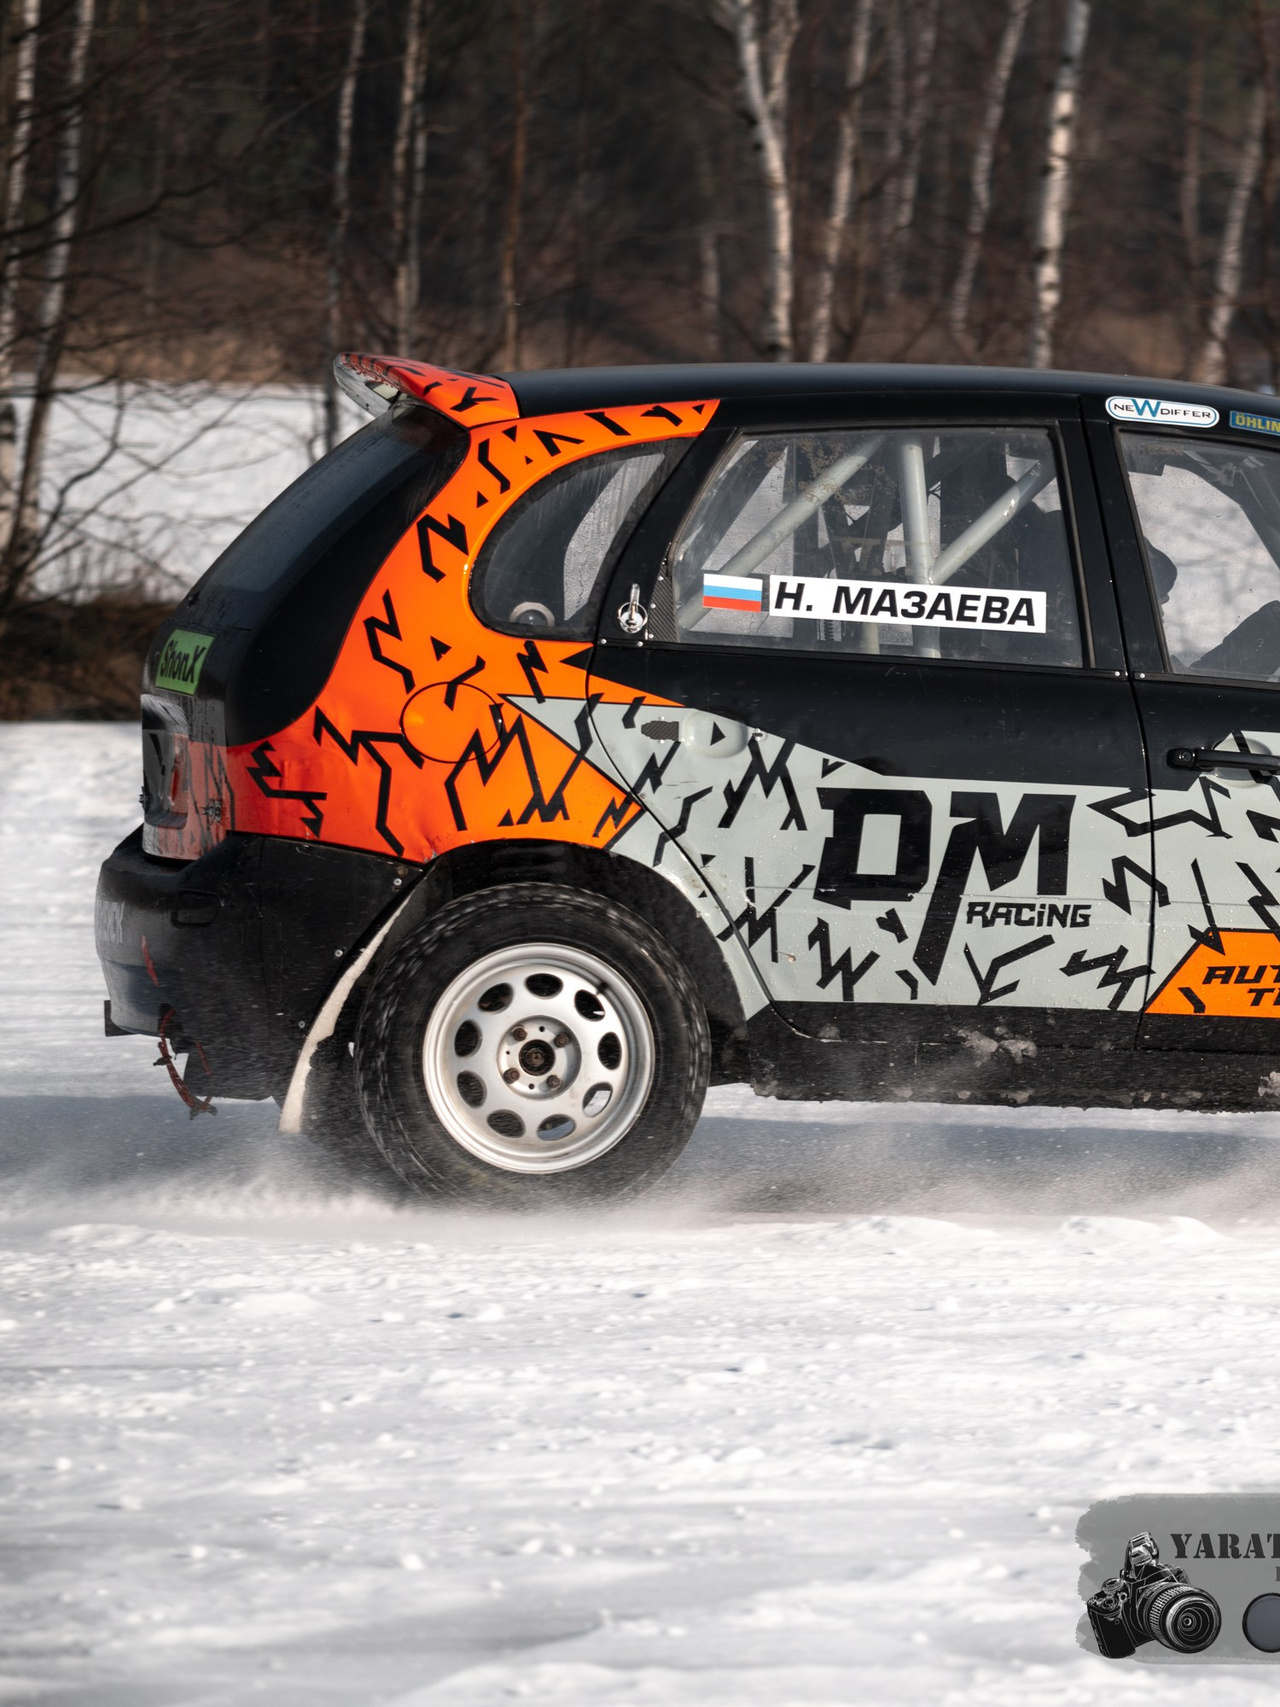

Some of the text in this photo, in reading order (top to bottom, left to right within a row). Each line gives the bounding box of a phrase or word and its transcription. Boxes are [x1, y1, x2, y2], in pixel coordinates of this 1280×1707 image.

[774, 581, 1036, 627] Н. МАЗАЕВА
[813, 787, 1077, 986] DM
